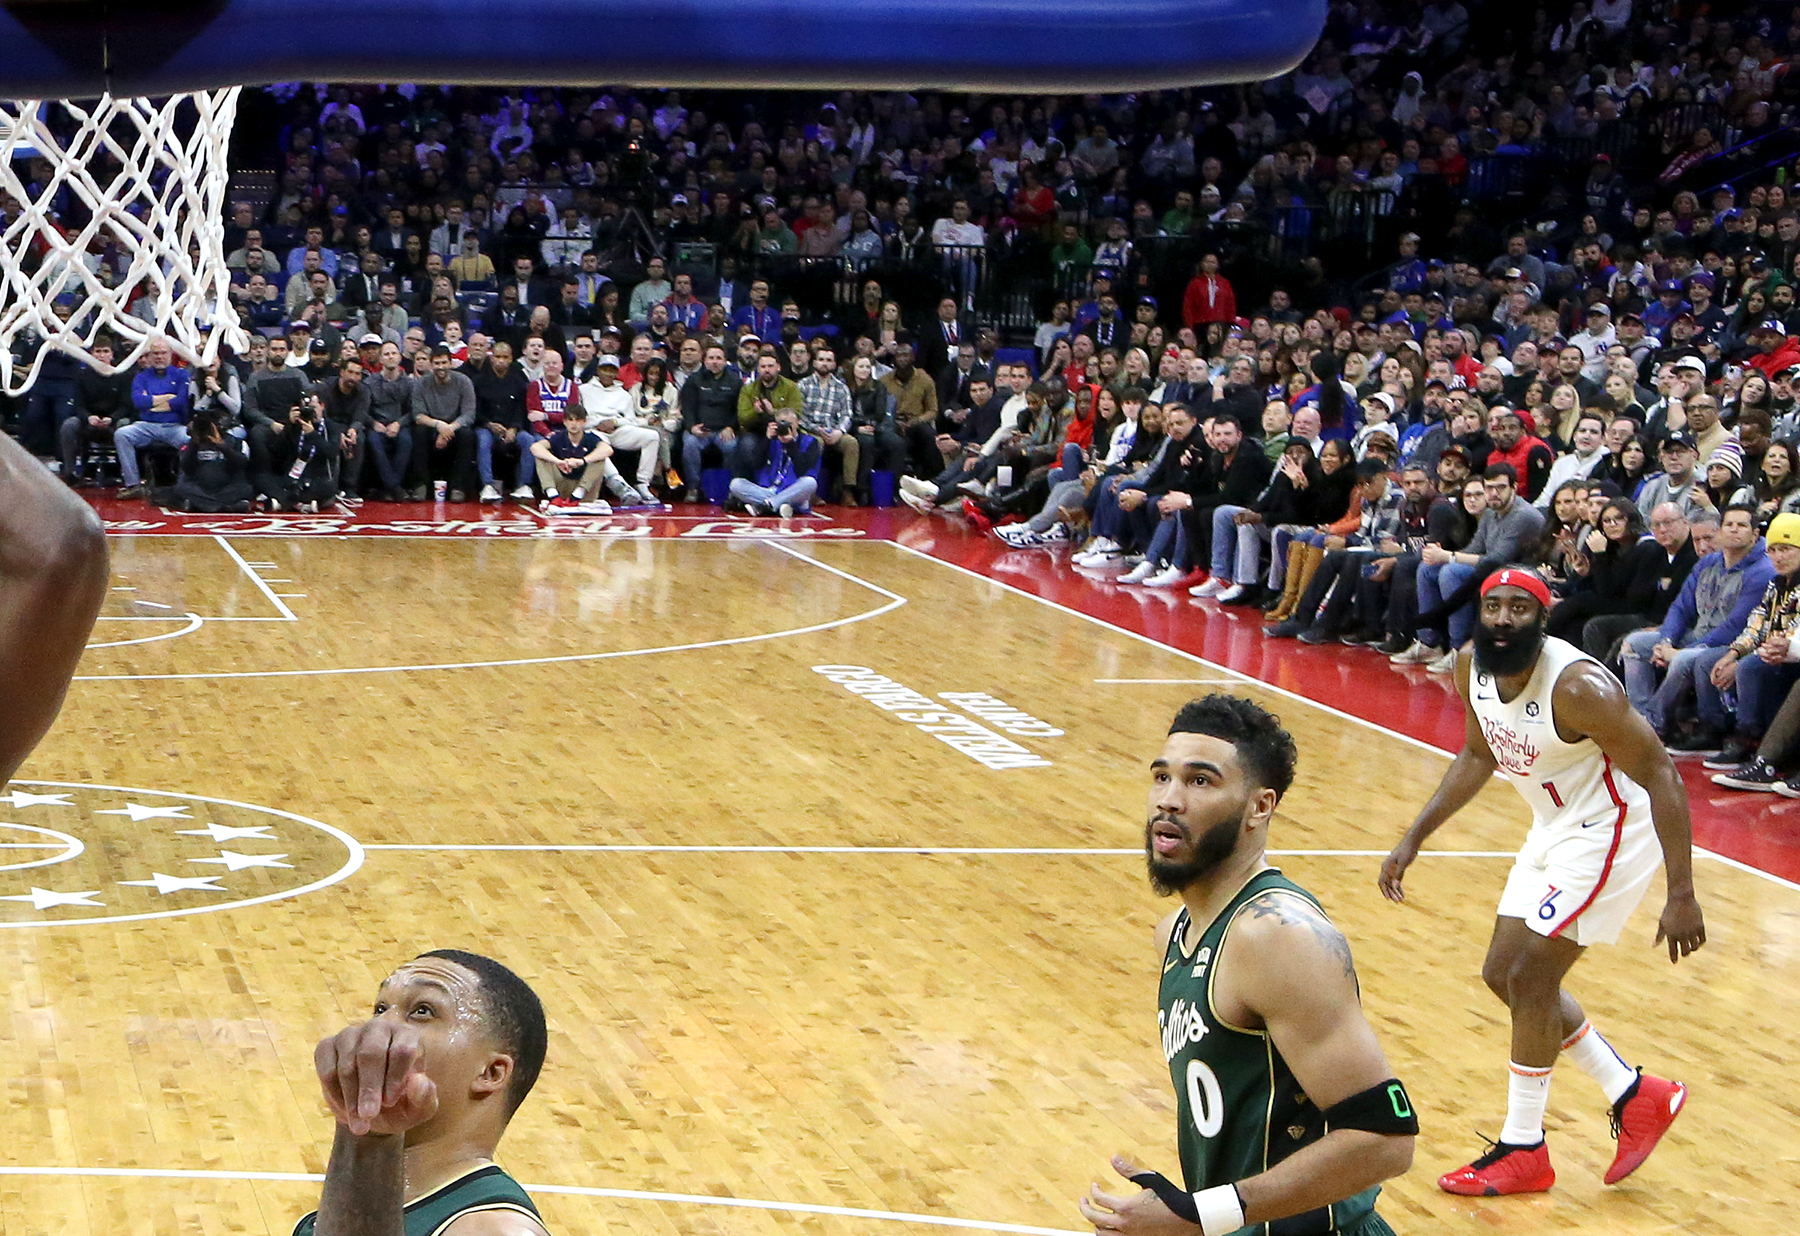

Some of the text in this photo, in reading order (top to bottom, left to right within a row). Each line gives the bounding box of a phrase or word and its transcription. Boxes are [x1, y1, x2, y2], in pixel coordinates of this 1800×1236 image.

[209, 518, 653, 537] Brotherly
[680, 521, 866, 538] Love
[810, 664, 1053, 770] WELLS FARGO
[937, 691, 1065, 737] CENTER
[1483, 716, 1541, 767] Brotherly
[1541, 781, 1565, 808] 1
[1538, 883, 1562, 920] 76
[1186, 1058, 1224, 1138] 0
